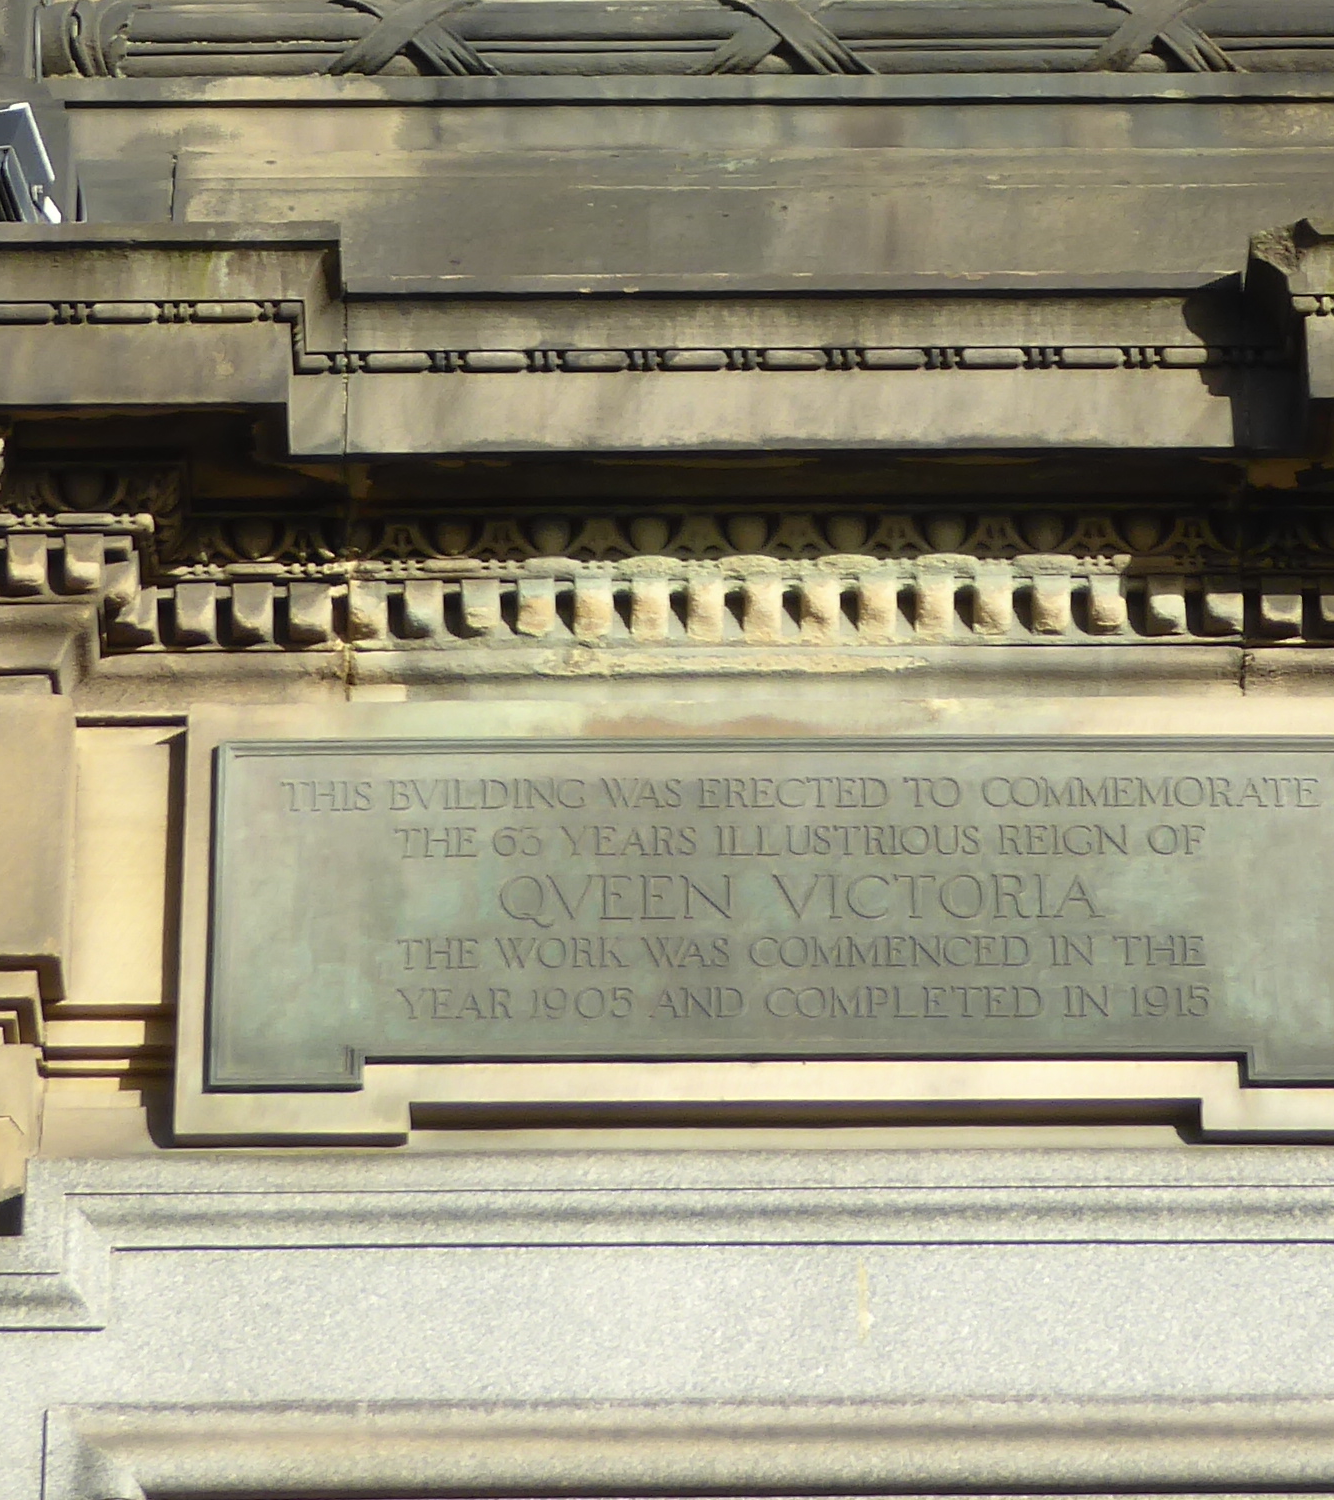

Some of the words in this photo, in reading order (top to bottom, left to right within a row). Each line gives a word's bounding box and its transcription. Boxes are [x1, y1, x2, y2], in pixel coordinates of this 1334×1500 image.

[281, 781, 371, 812] THIS
[388, 778, 585, 811] BVILDING
[600, 778, 682, 810] WAS
[698, 777, 887, 810] ERECTED
[903, 777, 961, 808] TO
[981, 776, 1321, 808] COMMEMORATE
[395, 826, 477, 858] THE
[559, 825, 696, 857] YEARS
[714, 824, 980, 857] ILLUSTRIOUS
[998, 823, 1127, 855] REIGN
[1147, 823, 1206, 855] OF
[499, 874, 732, 928] QVEEN
[772, 873, 1106, 920] VICTORIA
[398, 937, 479, 970] THE
[495, 937, 628, 969] WORK
[641, 937, 730, 969] WAS
[749, 935, 1030, 969] COMMENCED
[1050, 935, 1094, 967] IN
[1112, 935, 1206, 967] THE
[396, 988, 513, 1020] YEAR
[529, 987, 632, 1019] 1905
[648, 987, 744, 1019] AND
[765, 985, 1042, 1019] COMPLETED
[1063, 985, 1109, 1017] IN
[1129, 984, 1211, 1017] 1915
